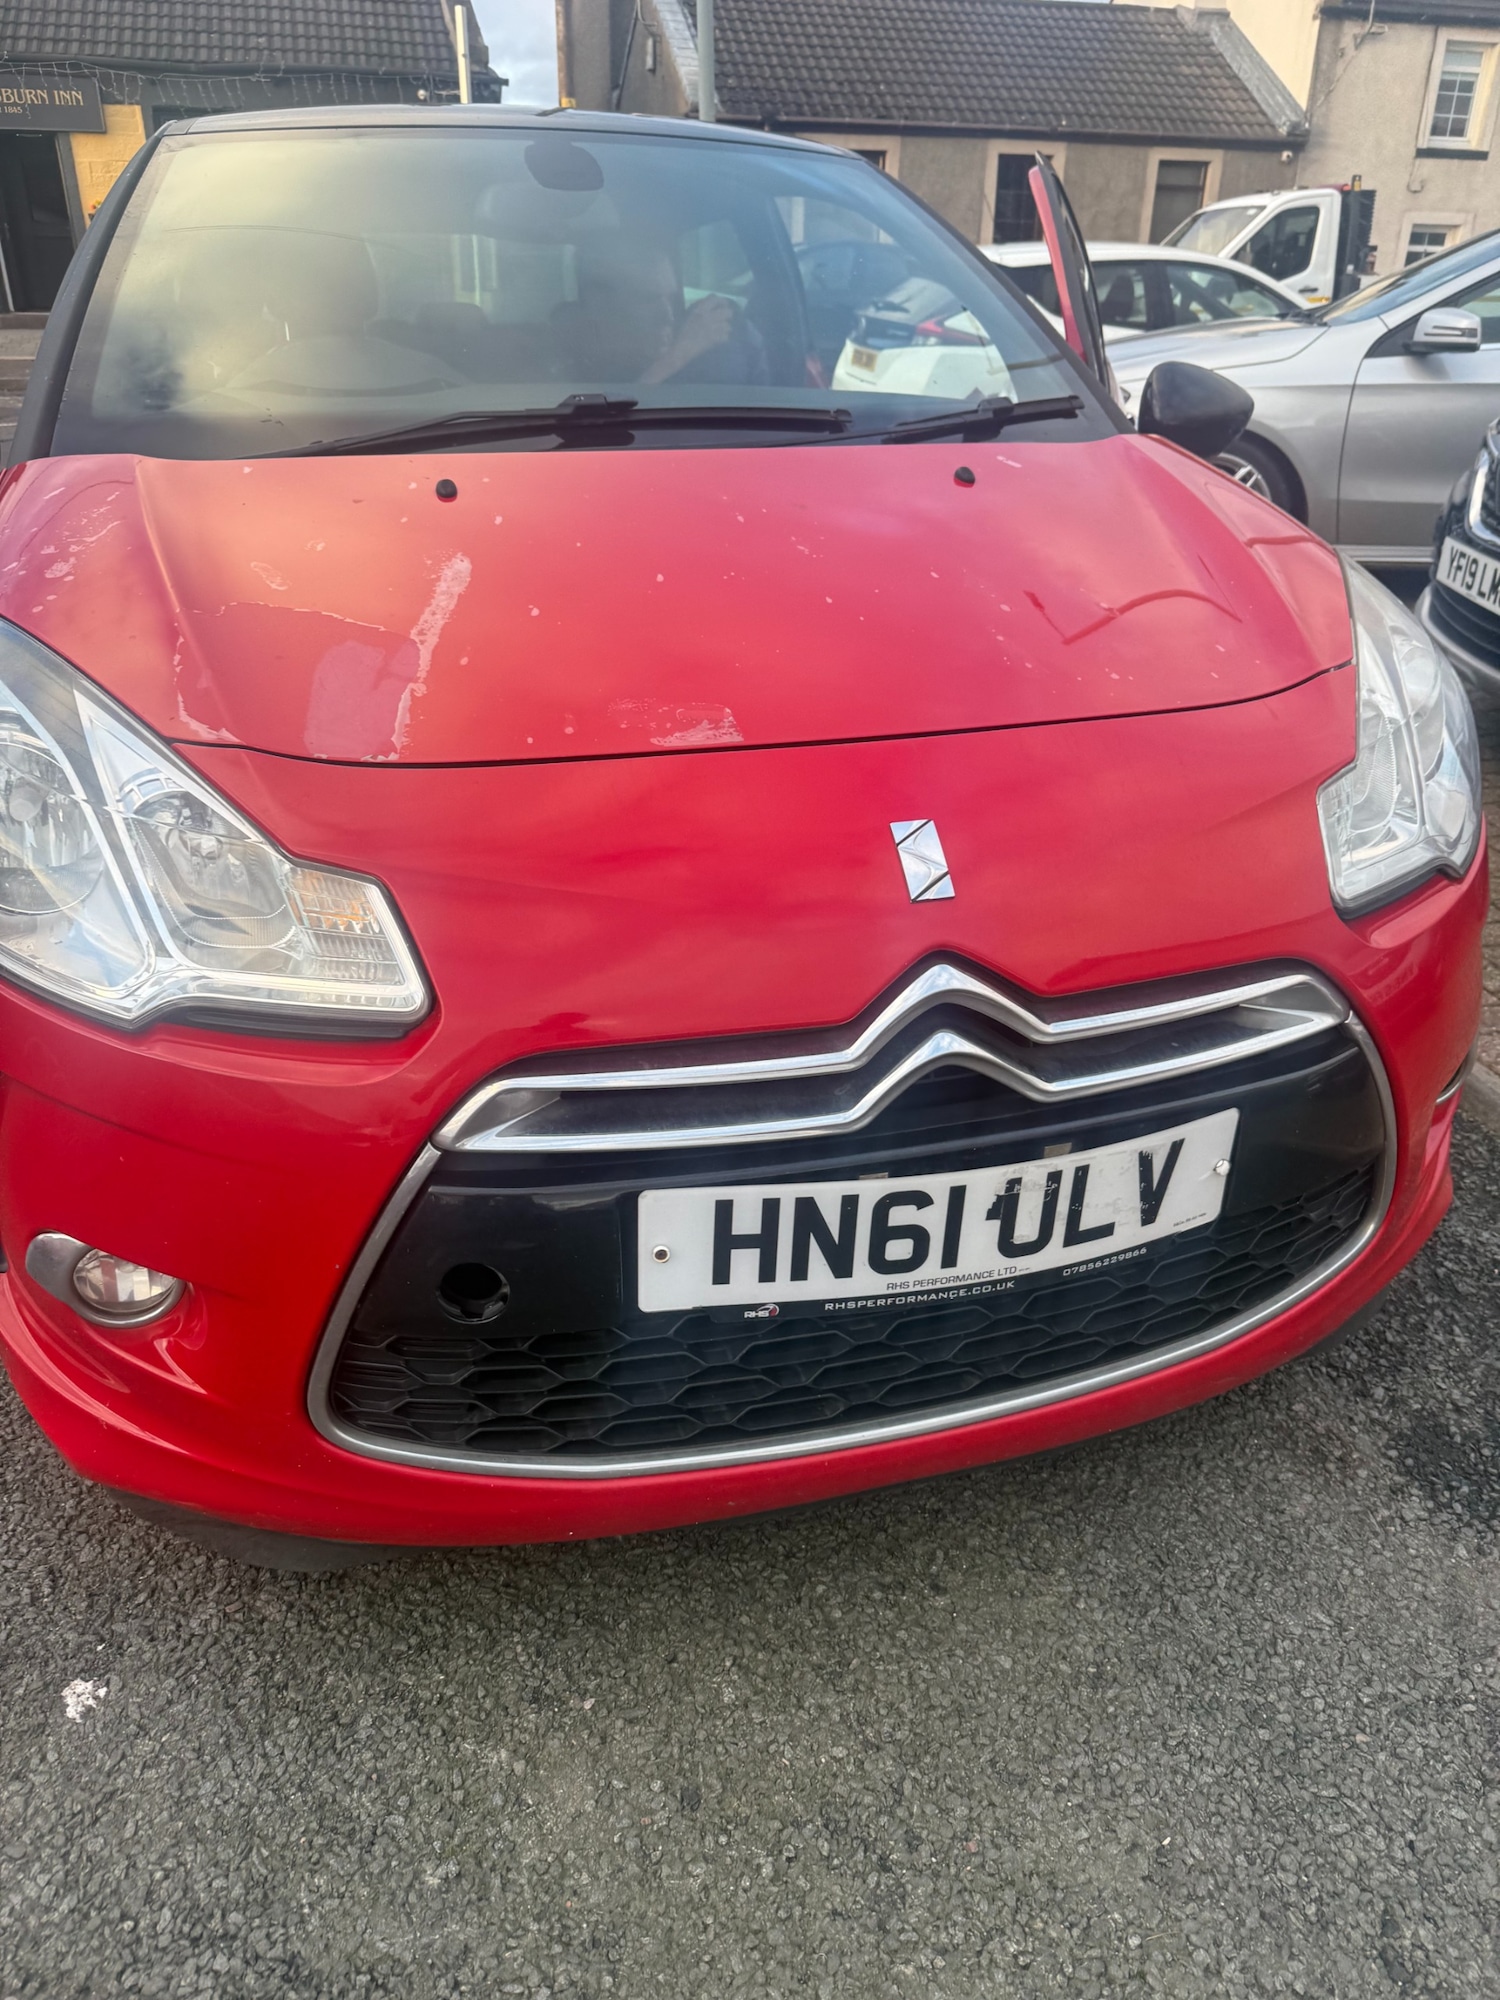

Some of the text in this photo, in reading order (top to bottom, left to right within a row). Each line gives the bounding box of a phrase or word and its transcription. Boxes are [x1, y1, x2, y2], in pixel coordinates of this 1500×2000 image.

[0, 88, 84, 105] BURN INN
[1447, 545, 1500, 607] YF19 LM
[711, 1137, 1186, 1286] HN61 ULV
[1062, 1247, 1147, 1276] 07856229866
[886, 1281, 910, 1291] RHS
[912, 1270, 995, 1288] PERFORMANCE
[997, 1265, 1017, 1277] LTD
[824, 1280, 1016, 1311] RHSPERFORMANCE.CO.UK
[743, 1310, 771, 1319] RHS
